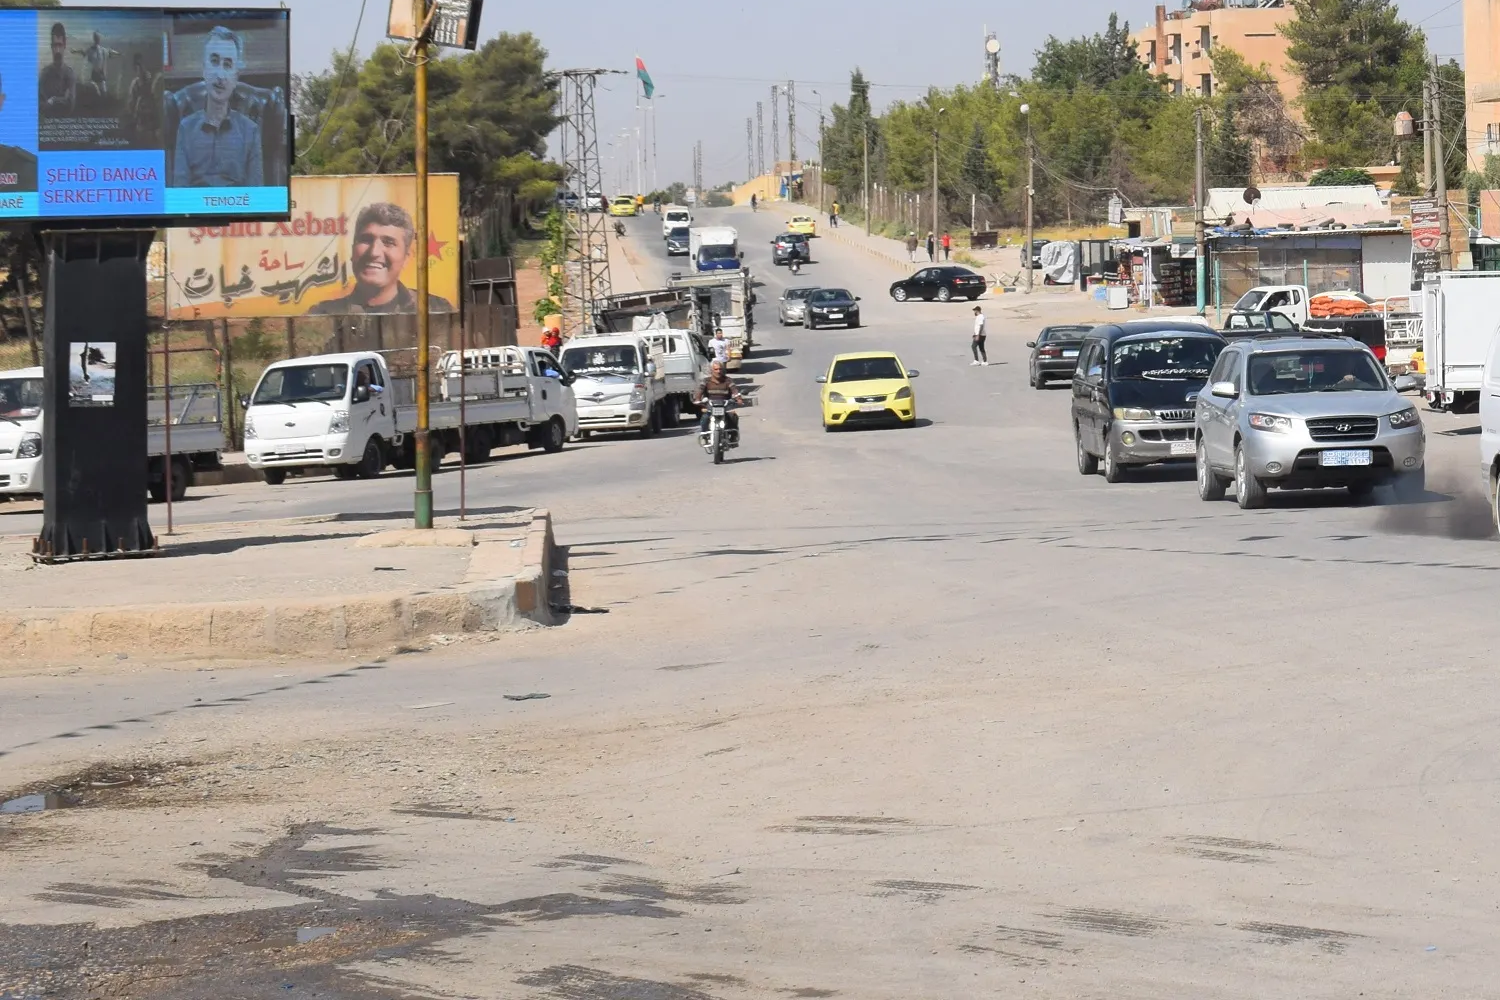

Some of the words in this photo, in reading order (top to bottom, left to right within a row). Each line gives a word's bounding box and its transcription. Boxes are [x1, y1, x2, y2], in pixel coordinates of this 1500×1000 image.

[46, 164, 97, 186] ŞEHÎD
[102, 167, 158, 182] BANGA
[44, 188, 154, 204] SERKEFTINYE
[203, 193, 250, 207] TEMOZÊ
[267, 212, 349, 238] Xebat
[258, 250, 305, 272] ساحة
[183, 264, 256, 309] خبات
[260, 252, 349, 304] الشهيد
